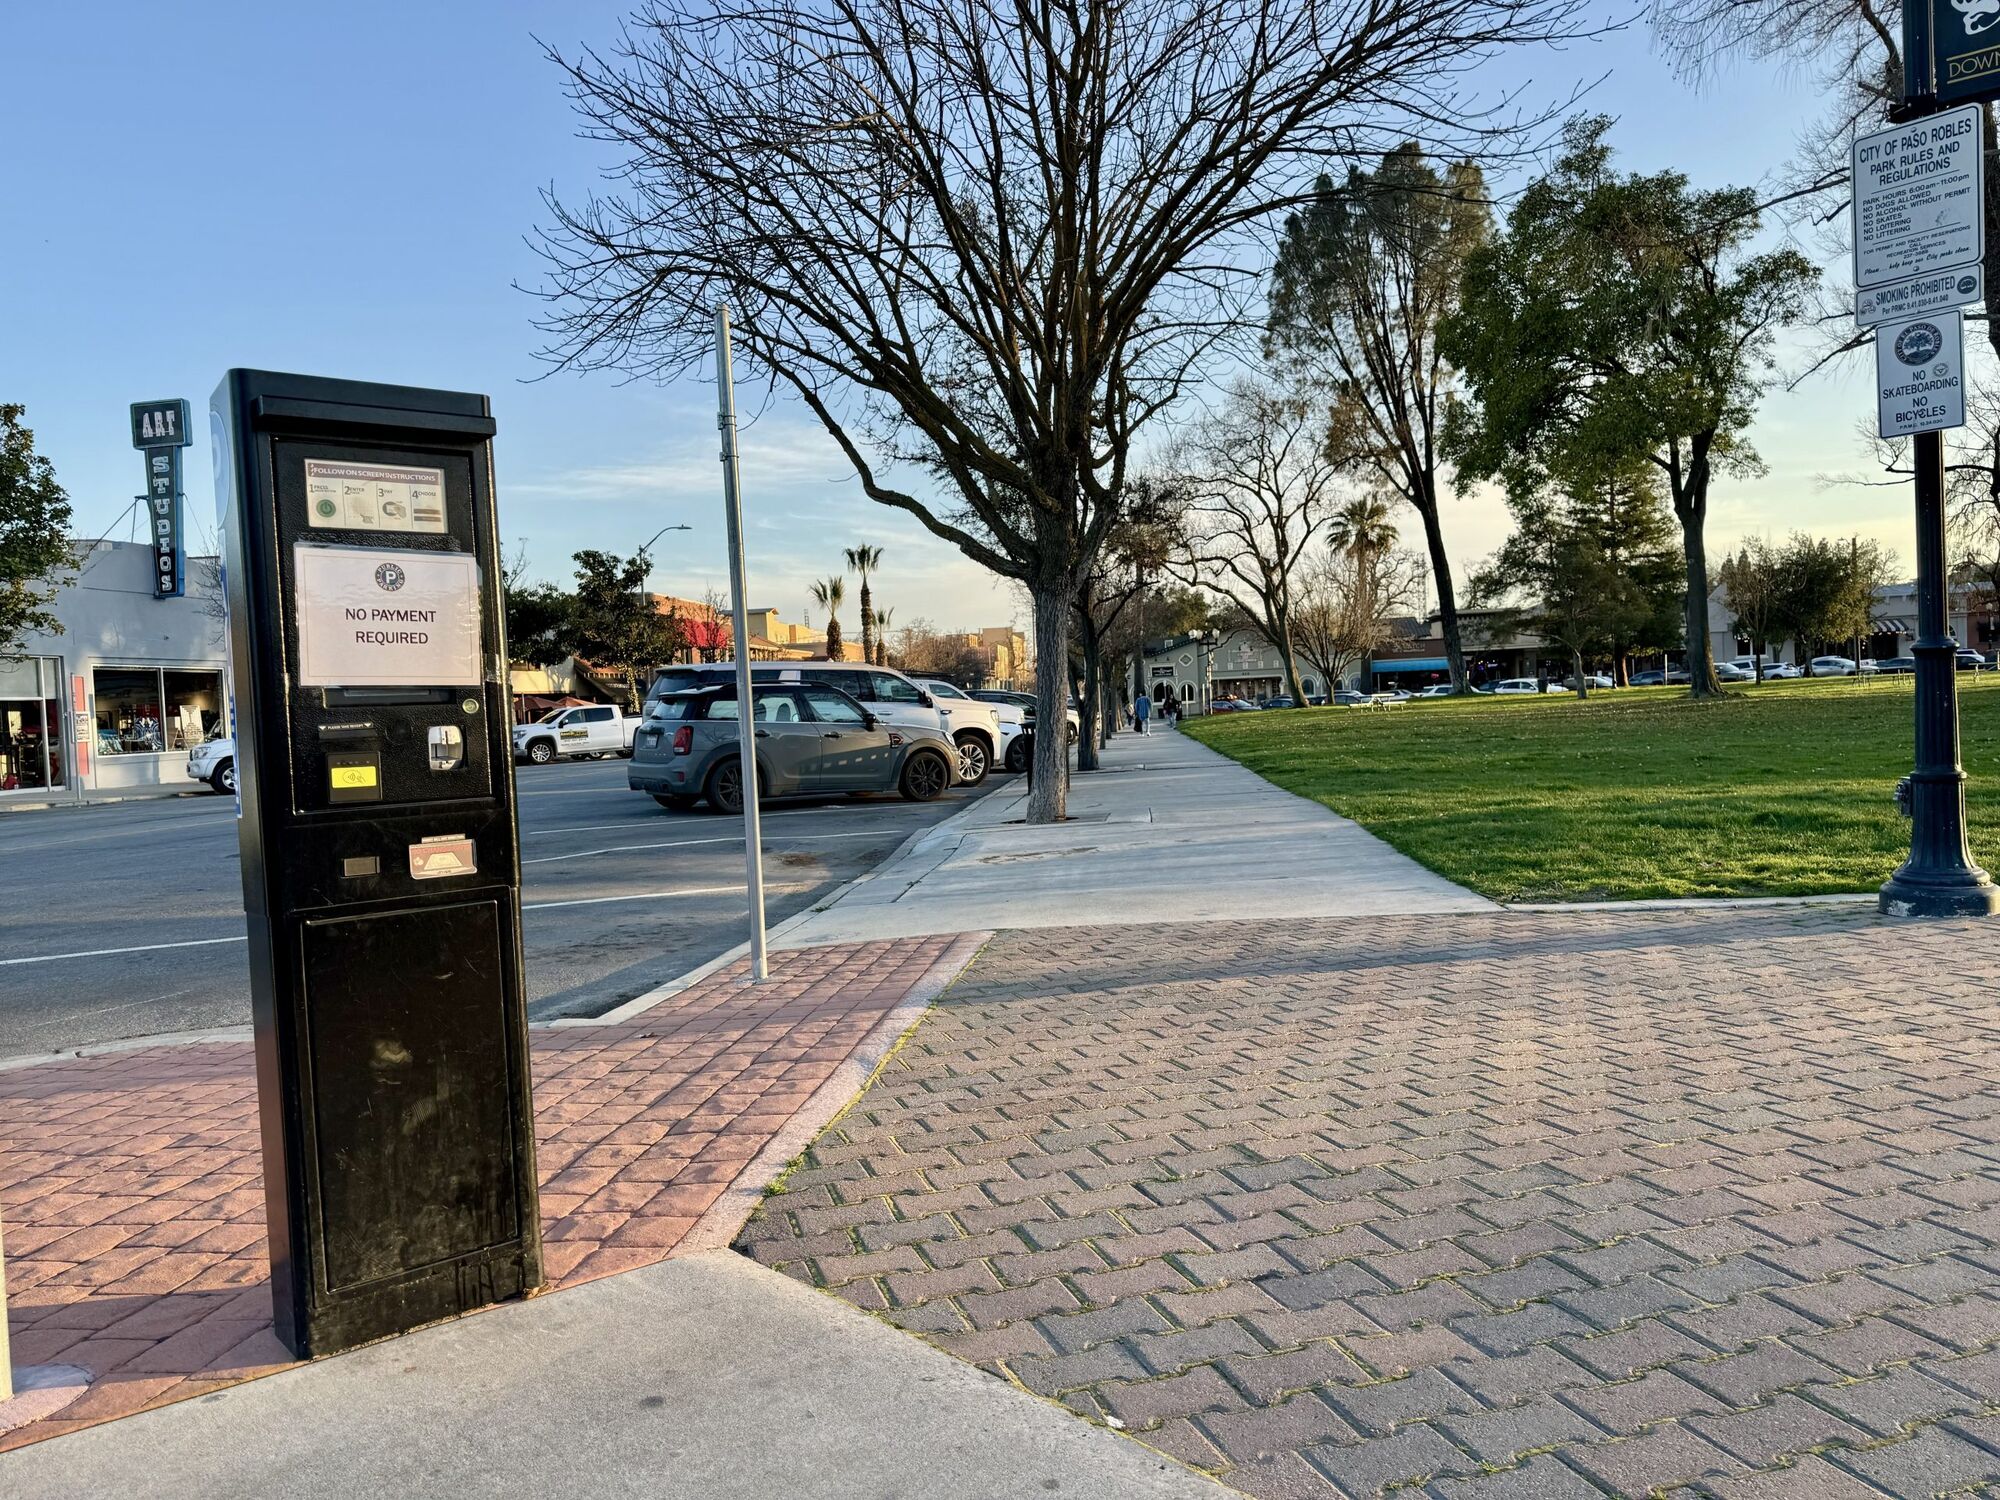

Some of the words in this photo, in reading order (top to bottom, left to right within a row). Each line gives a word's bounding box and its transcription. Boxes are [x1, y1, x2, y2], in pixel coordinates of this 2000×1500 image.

[1859, 144, 1880, 164] CITY
[1884, 139, 1897, 156] OF
[1901, 130, 1927, 151] PASO
[1931, 117, 1971, 142] ROBLES
[1870, 158, 1895, 175] PARK
[1900, 148, 1933, 167] RULES
[1938, 140, 1959, 156] AND
[1879, 156, 1950, 185] REGULATIONS
[1862, 196, 1879, 206] PARK
[1882, 189, 1906, 201] HOURS
[1863, 205, 1872, 213] NO
[1875, 199, 1895, 210] DOGS
[1898, 190, 1930, 204] ALLOWED
[1875, 204, 1907, 217] ALCOHOL
[1911, 195, 1941, 208] WITHOUT
[1944, 186, 1970, 198] PERMIT
[1876, 212, 1902, 224] SKATES
[1876, 217, 1911, 231] LOITERING
[1876, 225, 1910, 238] LITTERING
[1907, 235, 1929, 243] FACILITY
[1931, 224, 1970, 238] RESERVATIONS
[1886, 247, 1918, 258] RECREATION
[1920, 240, 1945, 250] SERVICES
[1889, 262, 1899, 270] help
[1926, 252, 1937, 261] City
[1875, 286, 1908, 305] SMOKING
[1910, 276, 1955, 296] PROHIBITED
[1882, 306, 1890, 315] Per
[1891, 303, 1905, 312] PRMC
[1909, 324, 1926, 332] PASO
[1912, 369, 1925, 381] NO
[1882, 376, 1958, 398] SKATEBOARDING
[1912, 396, 1927, 407] NO
[1896, 405, 1945, 422] BICYCLES
[142, 410, 175, 438] ART
[314, 467, 345, 475] FOLLOW
[385, 473, 435, 481] INSTRUCTIONS
[309, 485, 314, 493] 1
[345, 486, 350, 495] 2
[379, 489, 384, 497] 3
[412, 491, 418, 499] 4
[152, 456, 172, 591] STUDIOS
[377, 563, 401, 573] PUBLIC
[386, 571, 396, 583] P
[345, 608, 366, 621] NO
[372, 609, 436, 622] PAYMENT
[356, 632, 428, 646] REQUIRED
